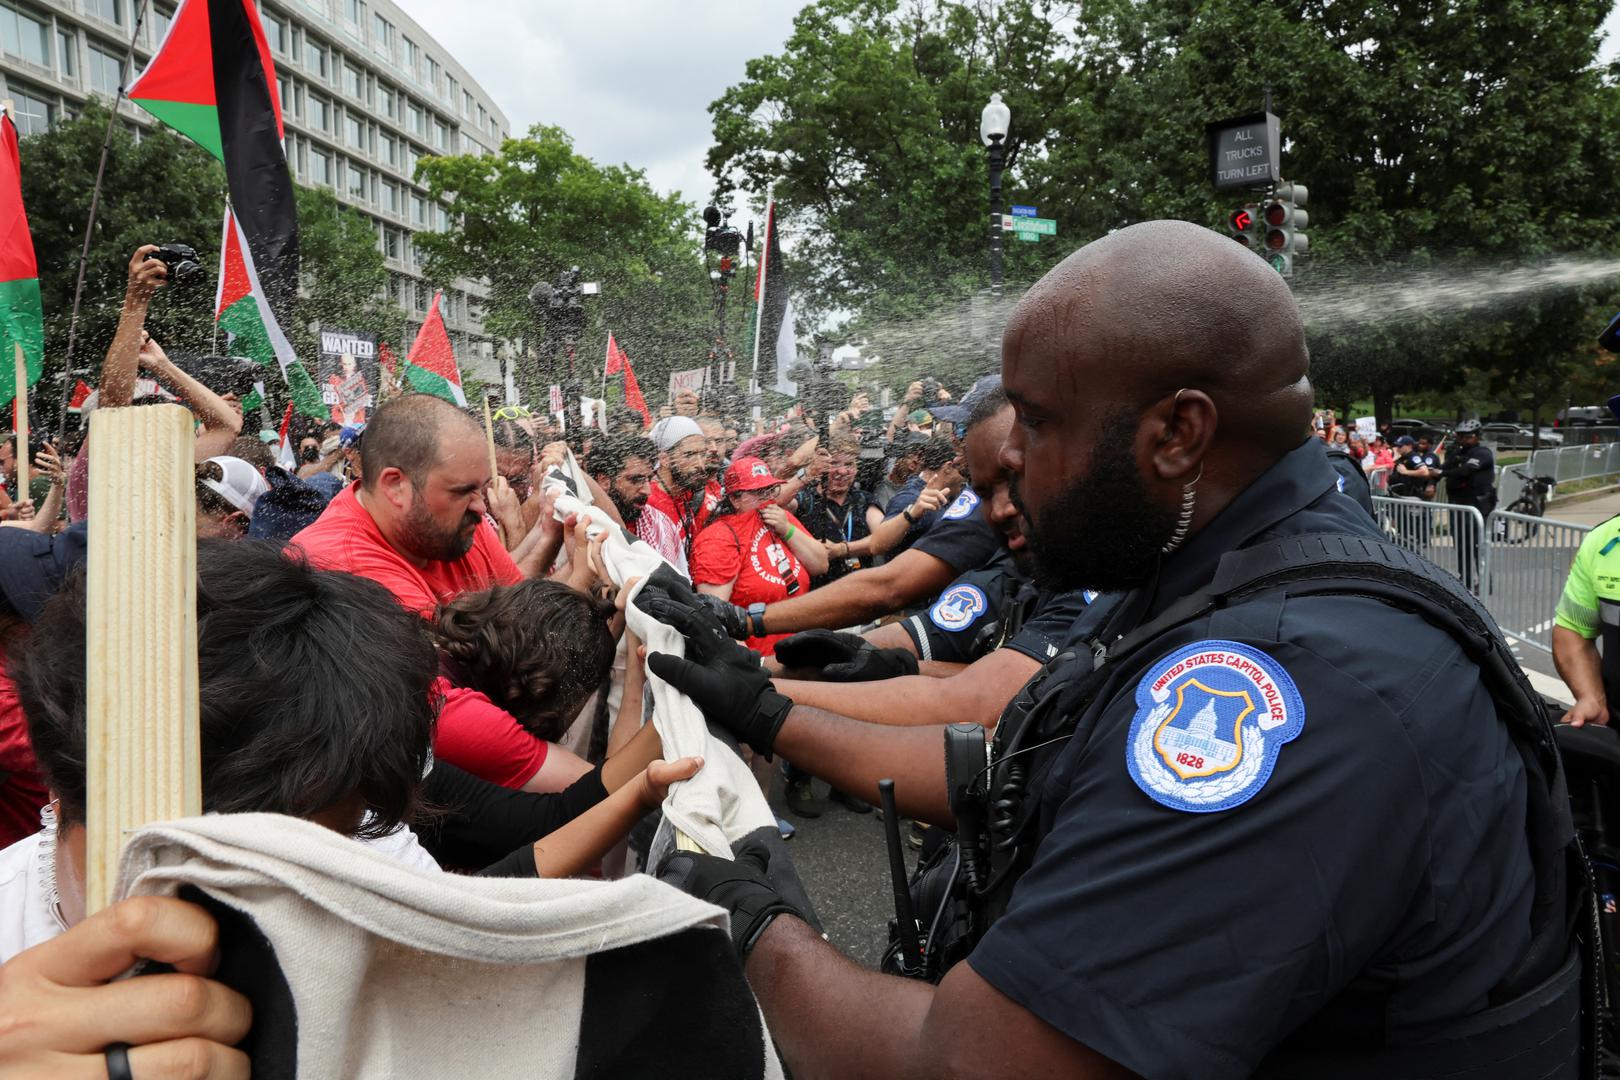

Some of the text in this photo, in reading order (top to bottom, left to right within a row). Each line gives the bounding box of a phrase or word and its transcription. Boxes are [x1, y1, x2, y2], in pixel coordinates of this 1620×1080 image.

[1234, 130, 1254, 142] ALL
[1225, 146, 1263, 161] TRUCKS
[1218, 163, 1270, 181] TURN LEFT
[321, 336, 374, 356] WANTED
[673, 373, 695, 390] NOT
[750, 525, 786, 586] PARTY FOR SOCIAL
[1152, 653, 1284, 721] UNITED STATES CAPITOL POLICE
[1176, 752, 1205, 769] 1828
